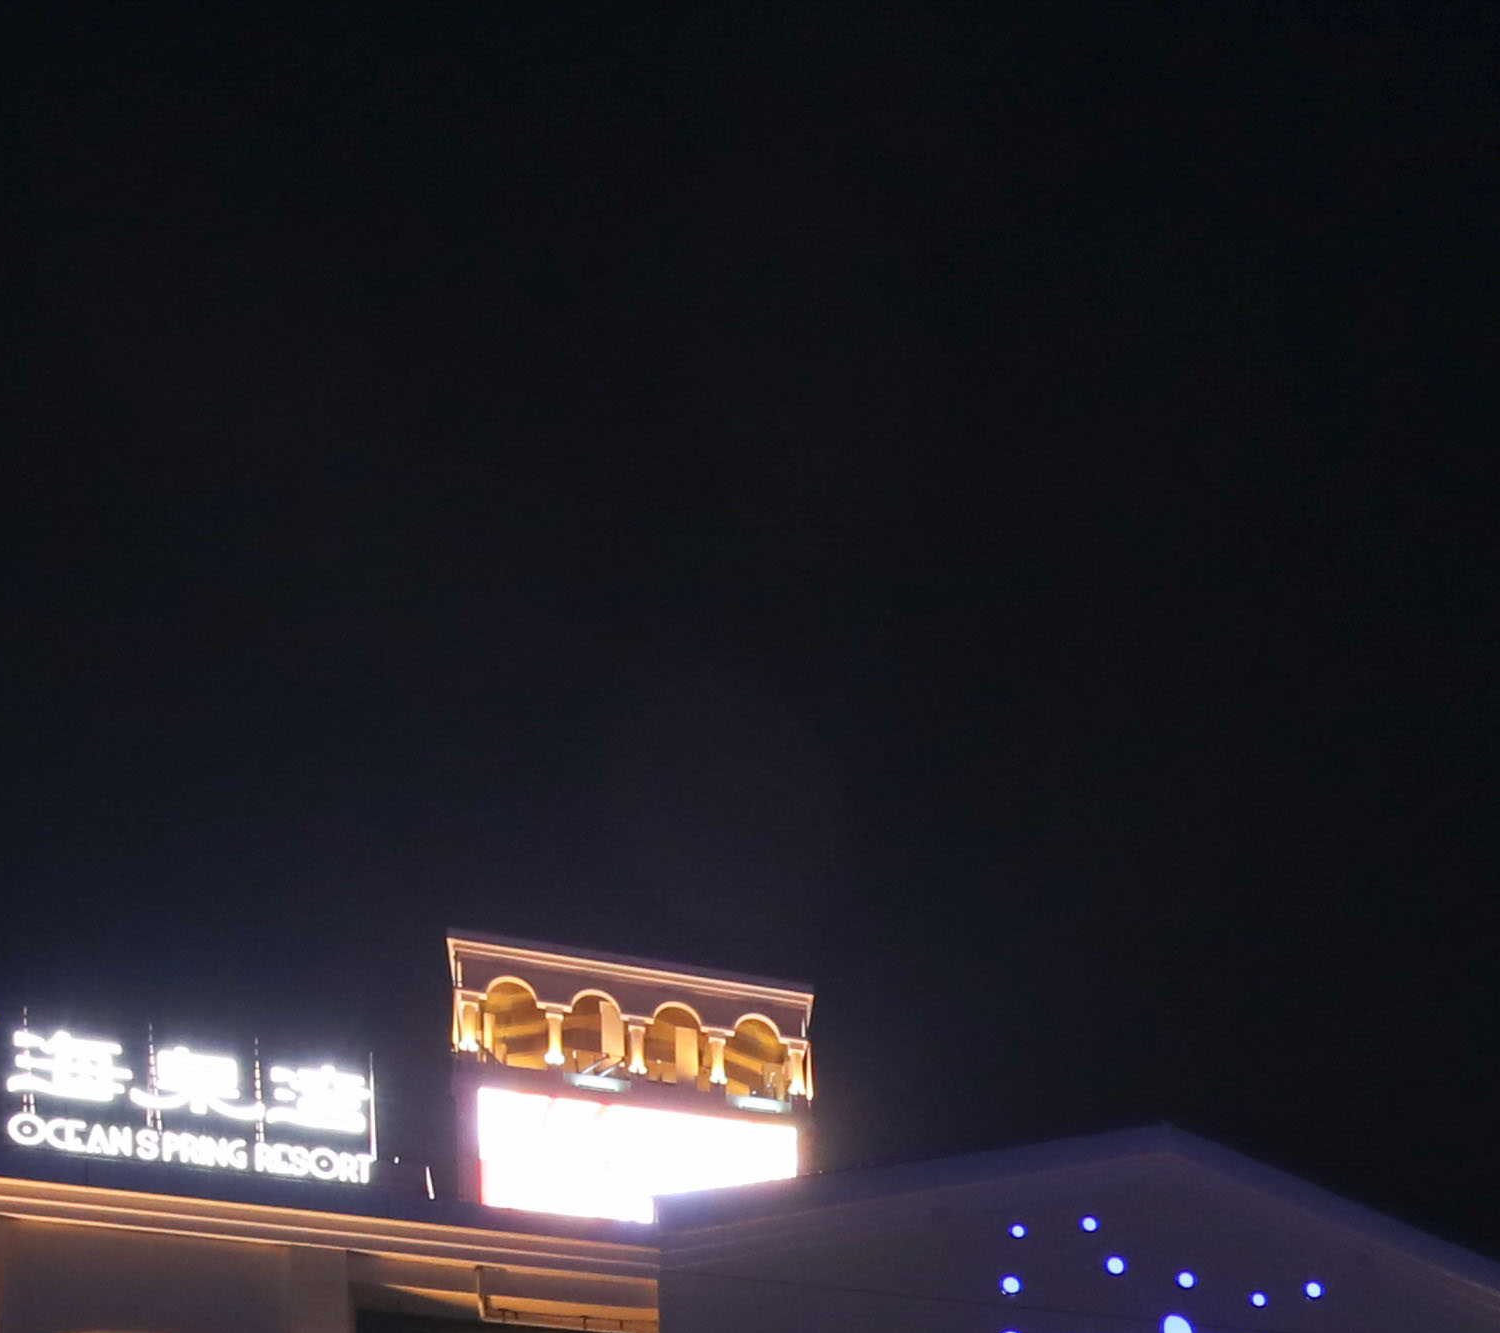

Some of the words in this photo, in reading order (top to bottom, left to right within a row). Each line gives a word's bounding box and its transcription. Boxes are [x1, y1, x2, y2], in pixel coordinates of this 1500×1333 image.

[7, 1113, 132, 1157] OCEAN
[136, 1129, 247, 1170] SPRING
[254, 1142, 375, 1184] RESORT
